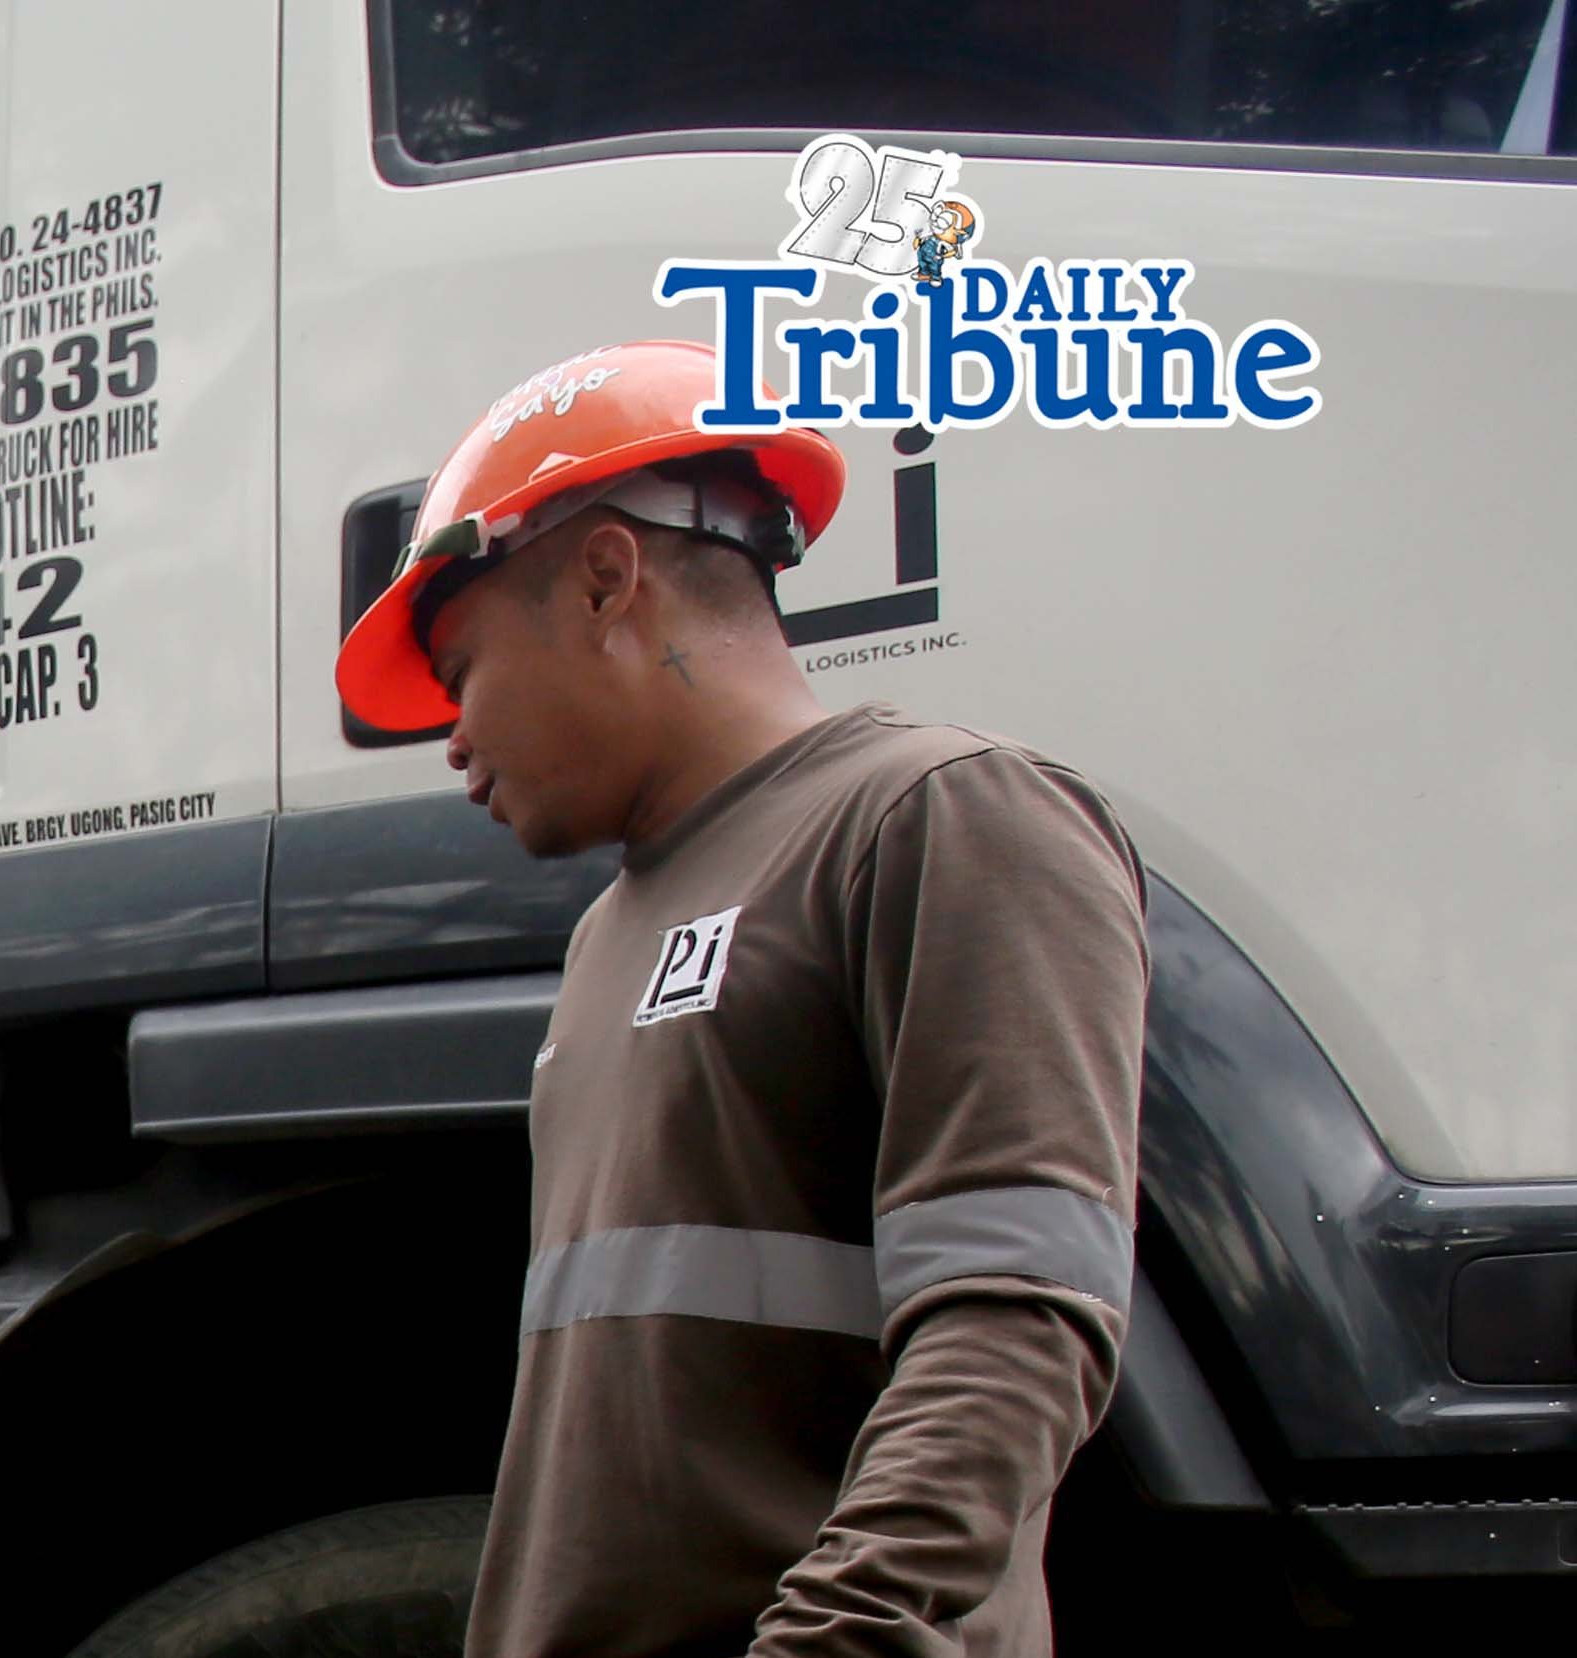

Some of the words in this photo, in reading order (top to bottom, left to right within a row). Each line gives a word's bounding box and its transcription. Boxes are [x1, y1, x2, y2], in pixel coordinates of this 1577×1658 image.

[32, 182, 163, 252] 24-4837
[115, 228, 162, 273] INC.
[21, 301, 42, 341] IN
[48, 289, 86, 334] THE
[94, 272, 159, 322] PHILS.
[59, 413, 100, 470] FOR
[107, 399, 159, 460] HIRE
[77, 633, 99, 711] 3
[806, 641, 915, 673] LOGISTICS
[922, 632, 967, 652] INC.
[25, 814, 67, 843] BRGY.
[71, 806, 127, 837] UGONG,
[130, 797, 176, 828] PASIG
[179, 791, 216, 821] CITY
